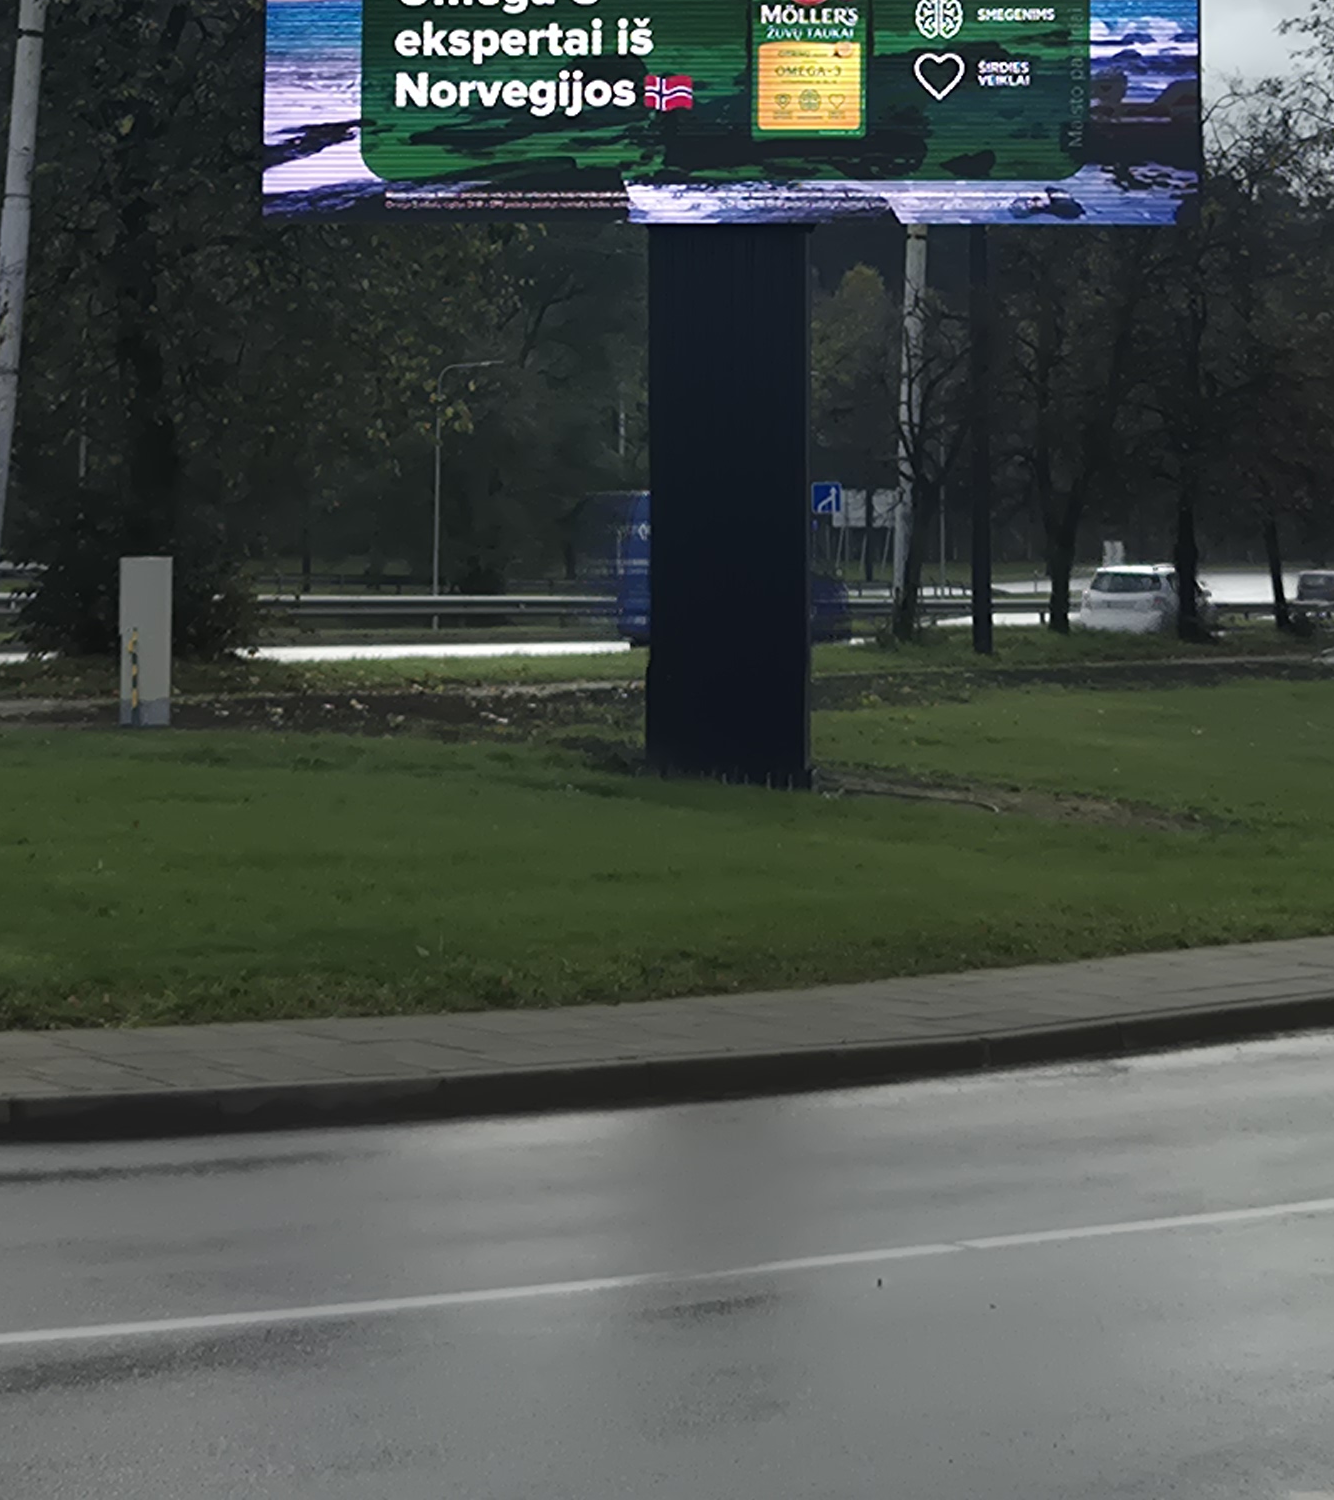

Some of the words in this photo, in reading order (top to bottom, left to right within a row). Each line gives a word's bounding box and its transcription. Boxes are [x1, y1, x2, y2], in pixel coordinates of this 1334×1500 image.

[977, 8, 1055, 21] SMEGENIMS
[394, 17, 603, 64] ekspertai
[617, 17, 654, 56] iš
[395, 70, 636, 117] Norvegijos
[978, 75, 1031, 86] VEIKLAI
